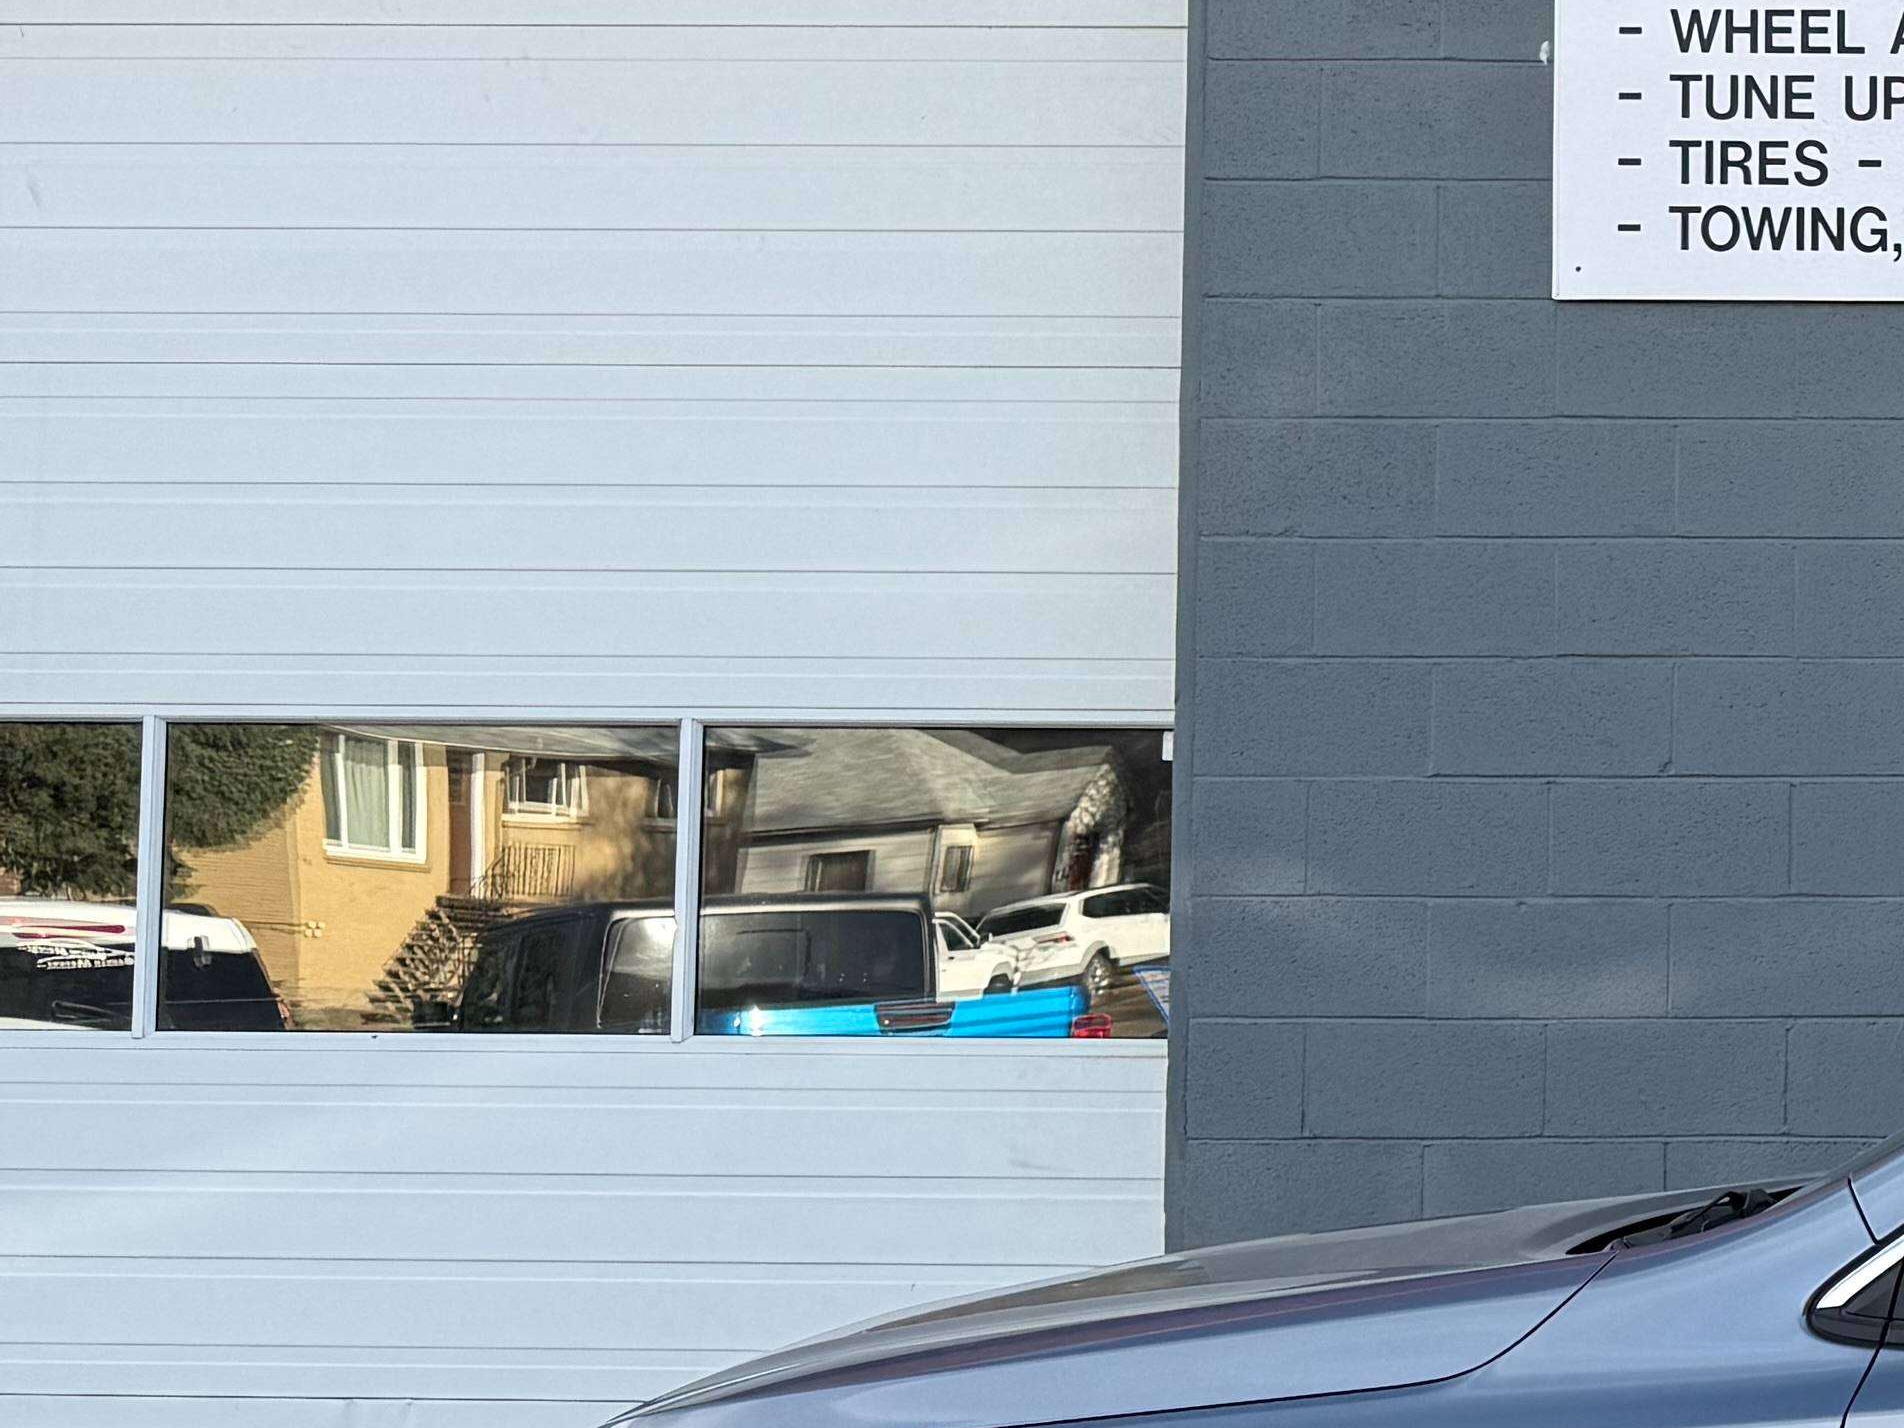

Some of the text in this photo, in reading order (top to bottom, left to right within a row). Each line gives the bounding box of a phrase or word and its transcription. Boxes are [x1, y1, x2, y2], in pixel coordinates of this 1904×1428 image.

[1671, 9, 1865, 54] WHEEL
[1670, 75, 1814, 120] TUNE
[1670, 140, 1828, 186] TIRES
[1669, 205, 1901, 261] TOWING,
